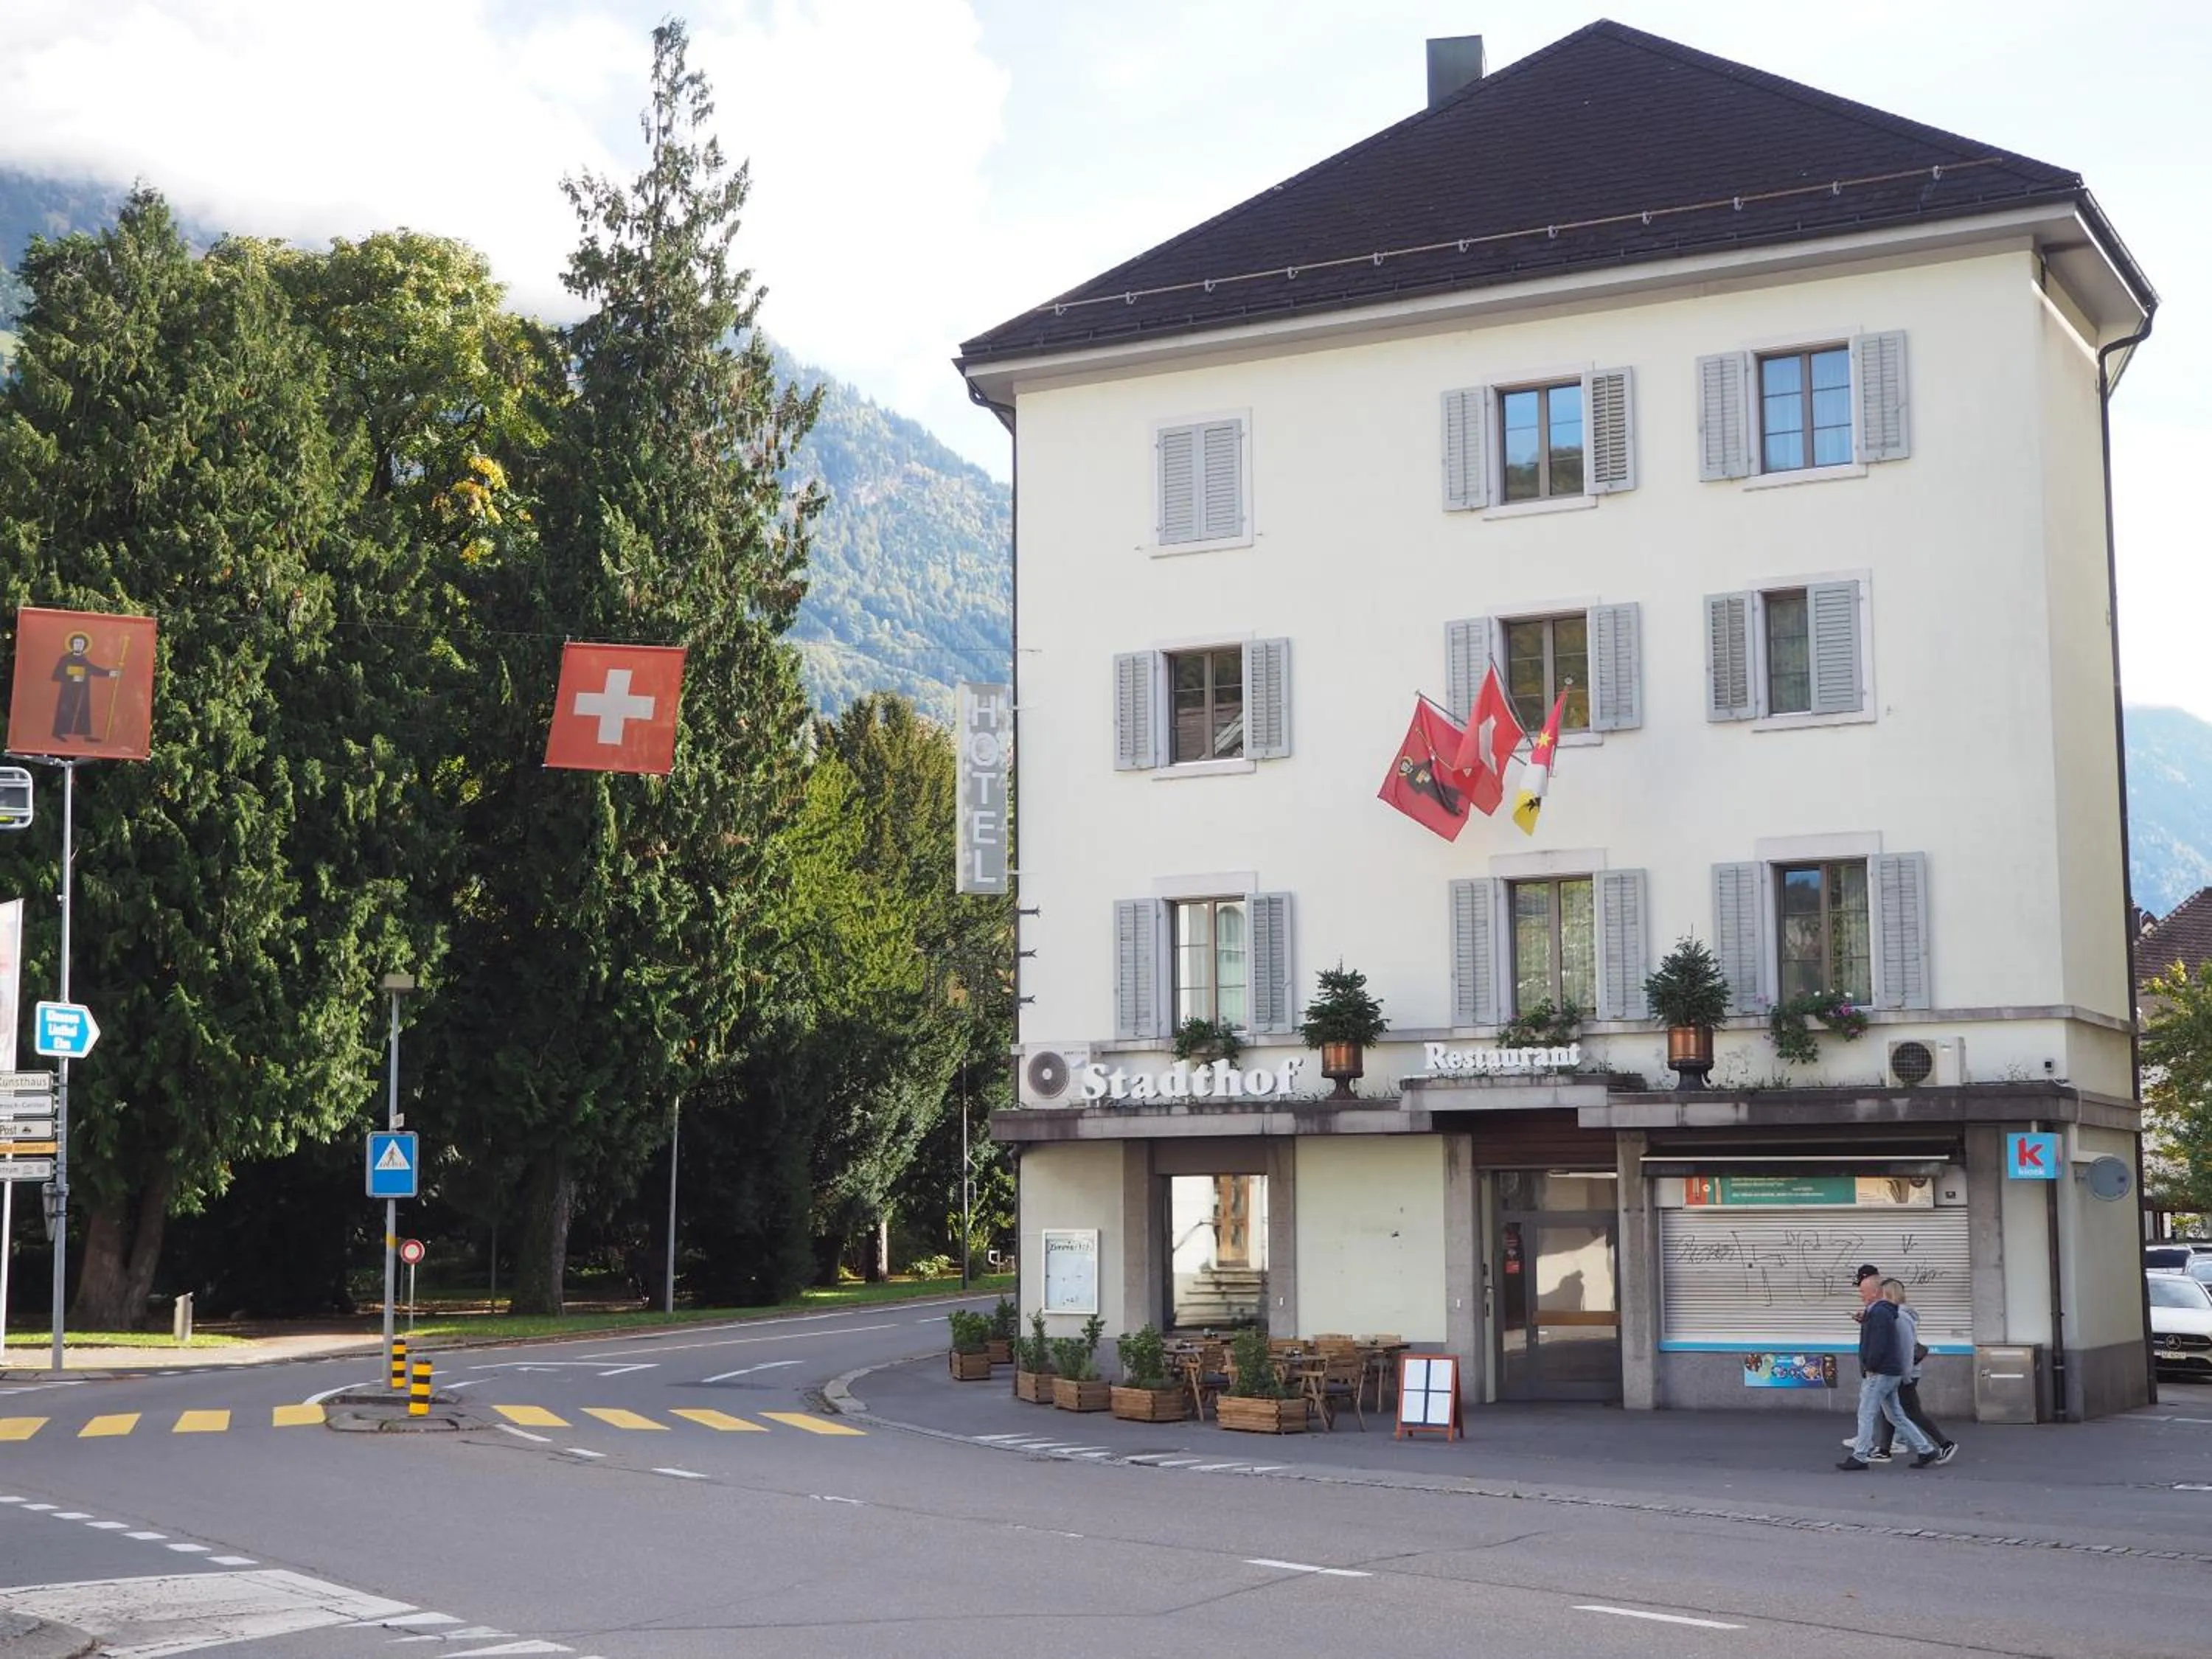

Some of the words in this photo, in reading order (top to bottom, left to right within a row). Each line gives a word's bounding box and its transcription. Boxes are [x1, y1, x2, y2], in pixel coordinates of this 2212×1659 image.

[971, 694, 998, 883] HOTEL
[1424, 1043, 1580, 1070] Restaurant
[1081, 1057, 1304, 1099] Stadthof
